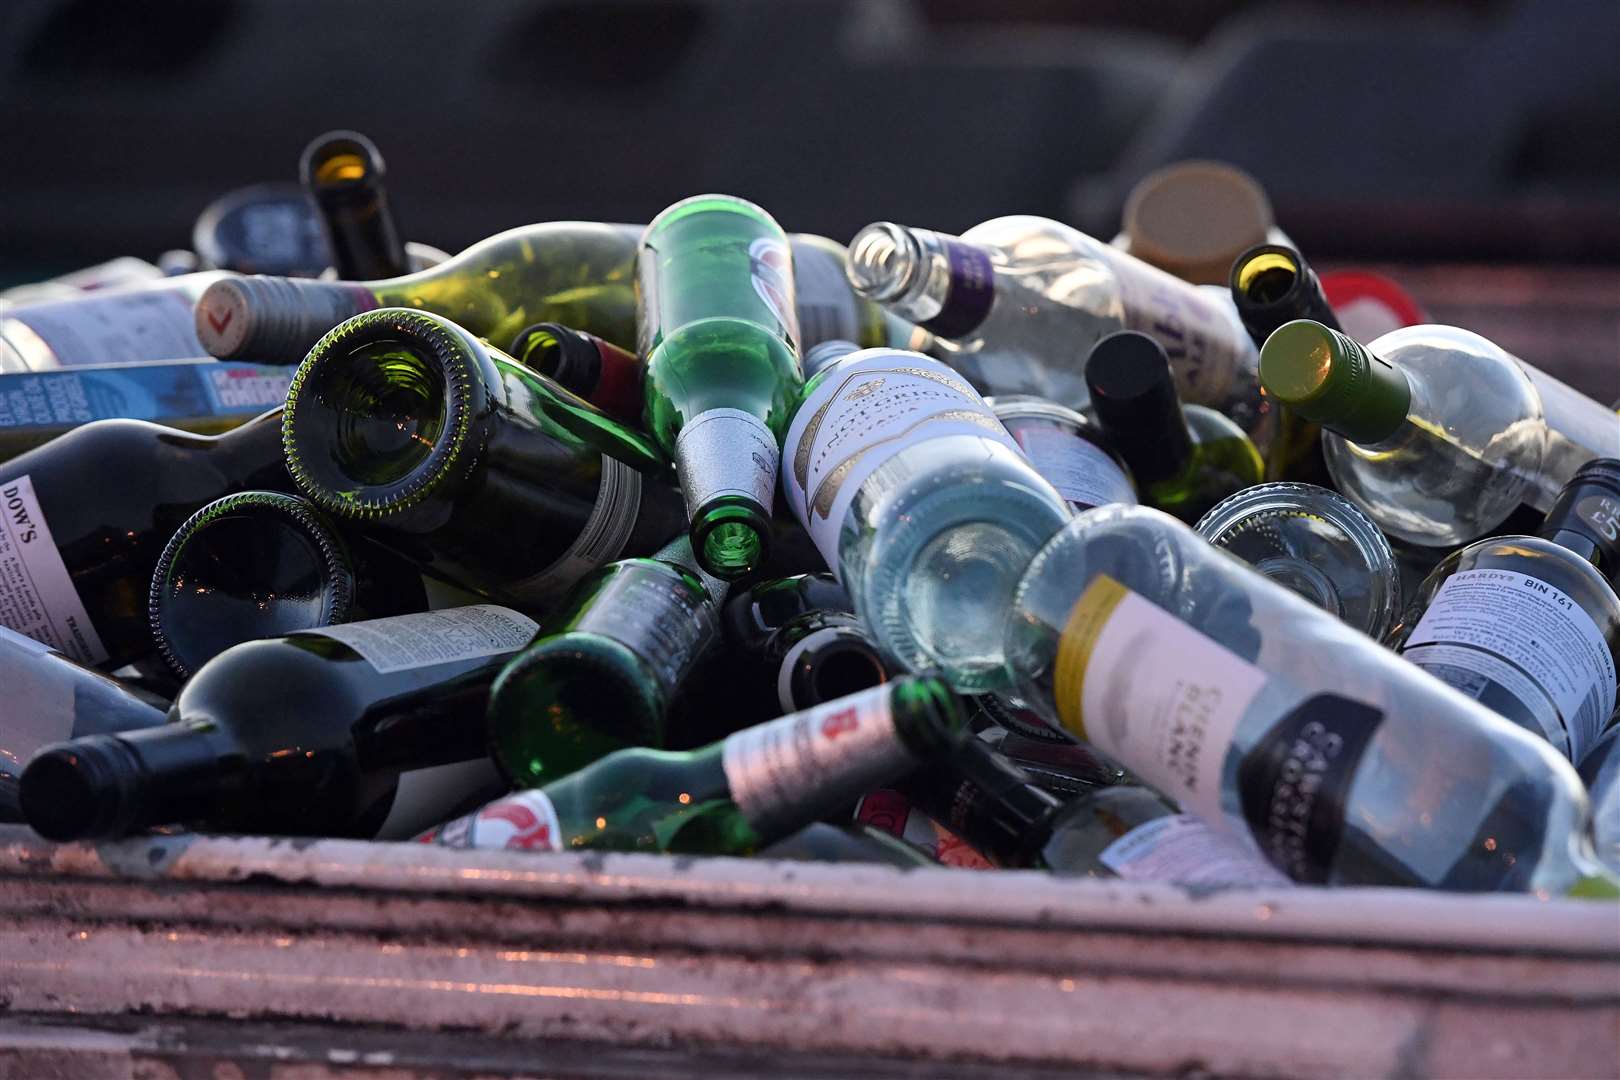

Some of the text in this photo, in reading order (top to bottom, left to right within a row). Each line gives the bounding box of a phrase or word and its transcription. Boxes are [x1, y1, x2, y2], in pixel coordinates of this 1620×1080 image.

[814, 407, 869, 473] PINOT
[873, 390, 970, 407] GRIGIO
[4, 486, 38, 544] DOW'S
[1524, 579, 1549, 595] BIN
[1552, 591, 1573, 611] 161
[1598, 642, 1613, 681] SHIRAZ
